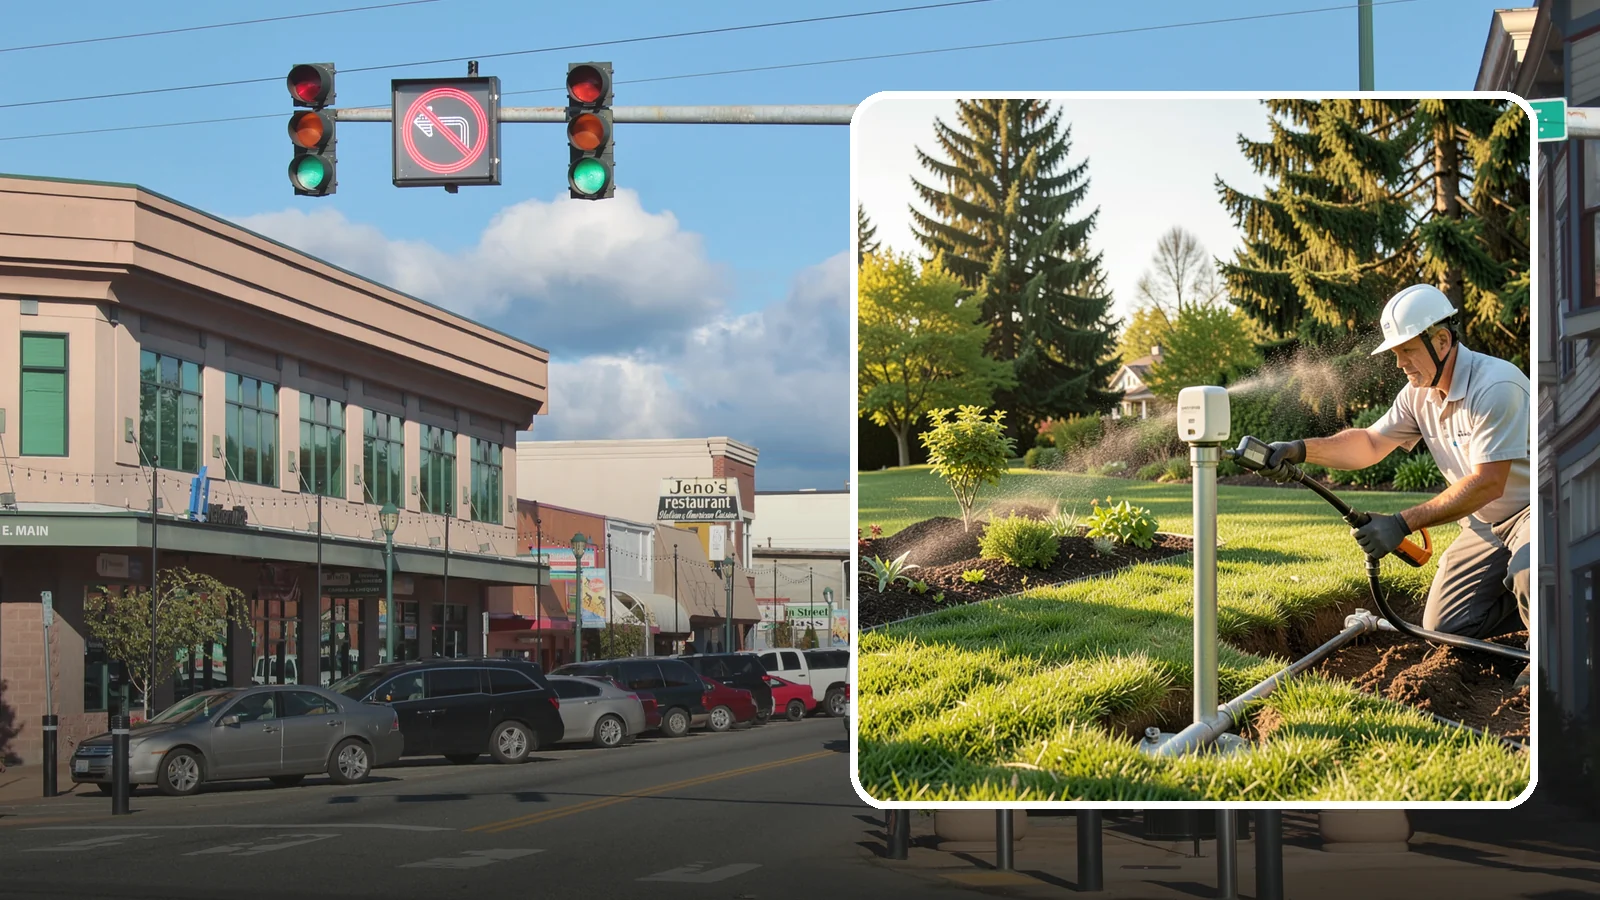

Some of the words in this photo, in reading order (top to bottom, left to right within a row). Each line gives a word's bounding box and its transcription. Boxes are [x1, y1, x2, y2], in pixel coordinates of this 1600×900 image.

[669, 480, 727, 494] Jeno's
[665, 496, 731, 509] restaurant
[2, 525, 13, 536] E.
[15, 525, 49, 536] MAIN
[797, 608, 828, 617] Street
[791, 619, 824, 627] lass
